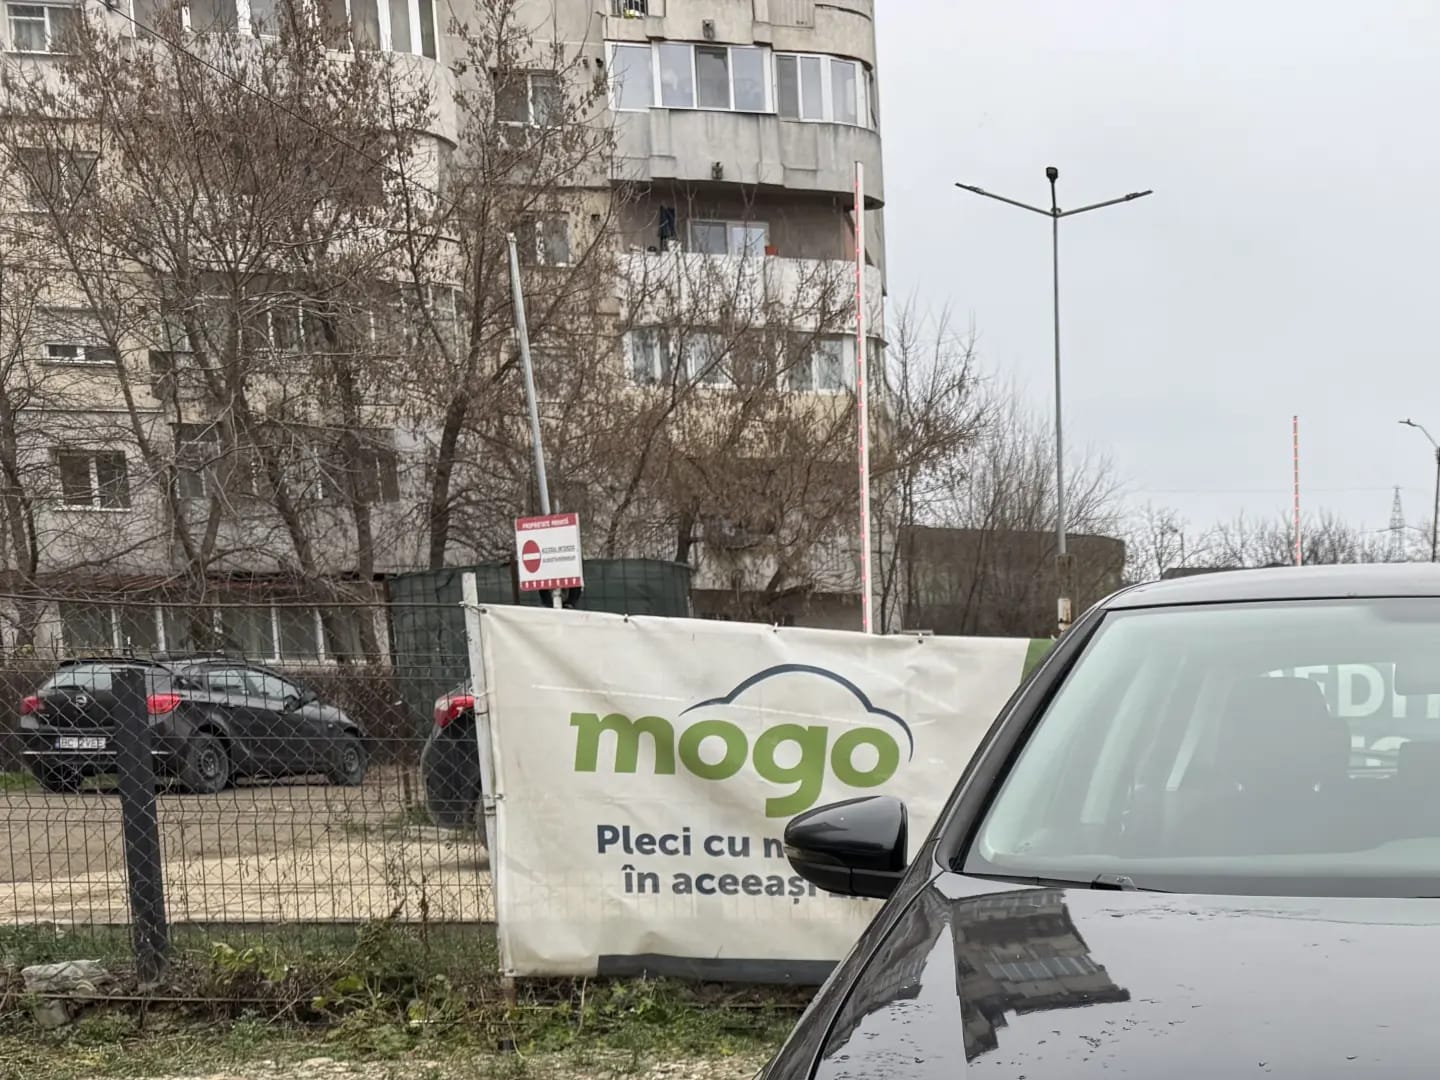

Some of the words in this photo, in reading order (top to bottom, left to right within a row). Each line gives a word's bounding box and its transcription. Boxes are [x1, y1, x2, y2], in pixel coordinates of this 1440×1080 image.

[570, 712, 900, 818] mogo
[597, 824, 691, 856] Pleci
[703, 835, 750, 857] cu
[621, 864, 660, 894] în
